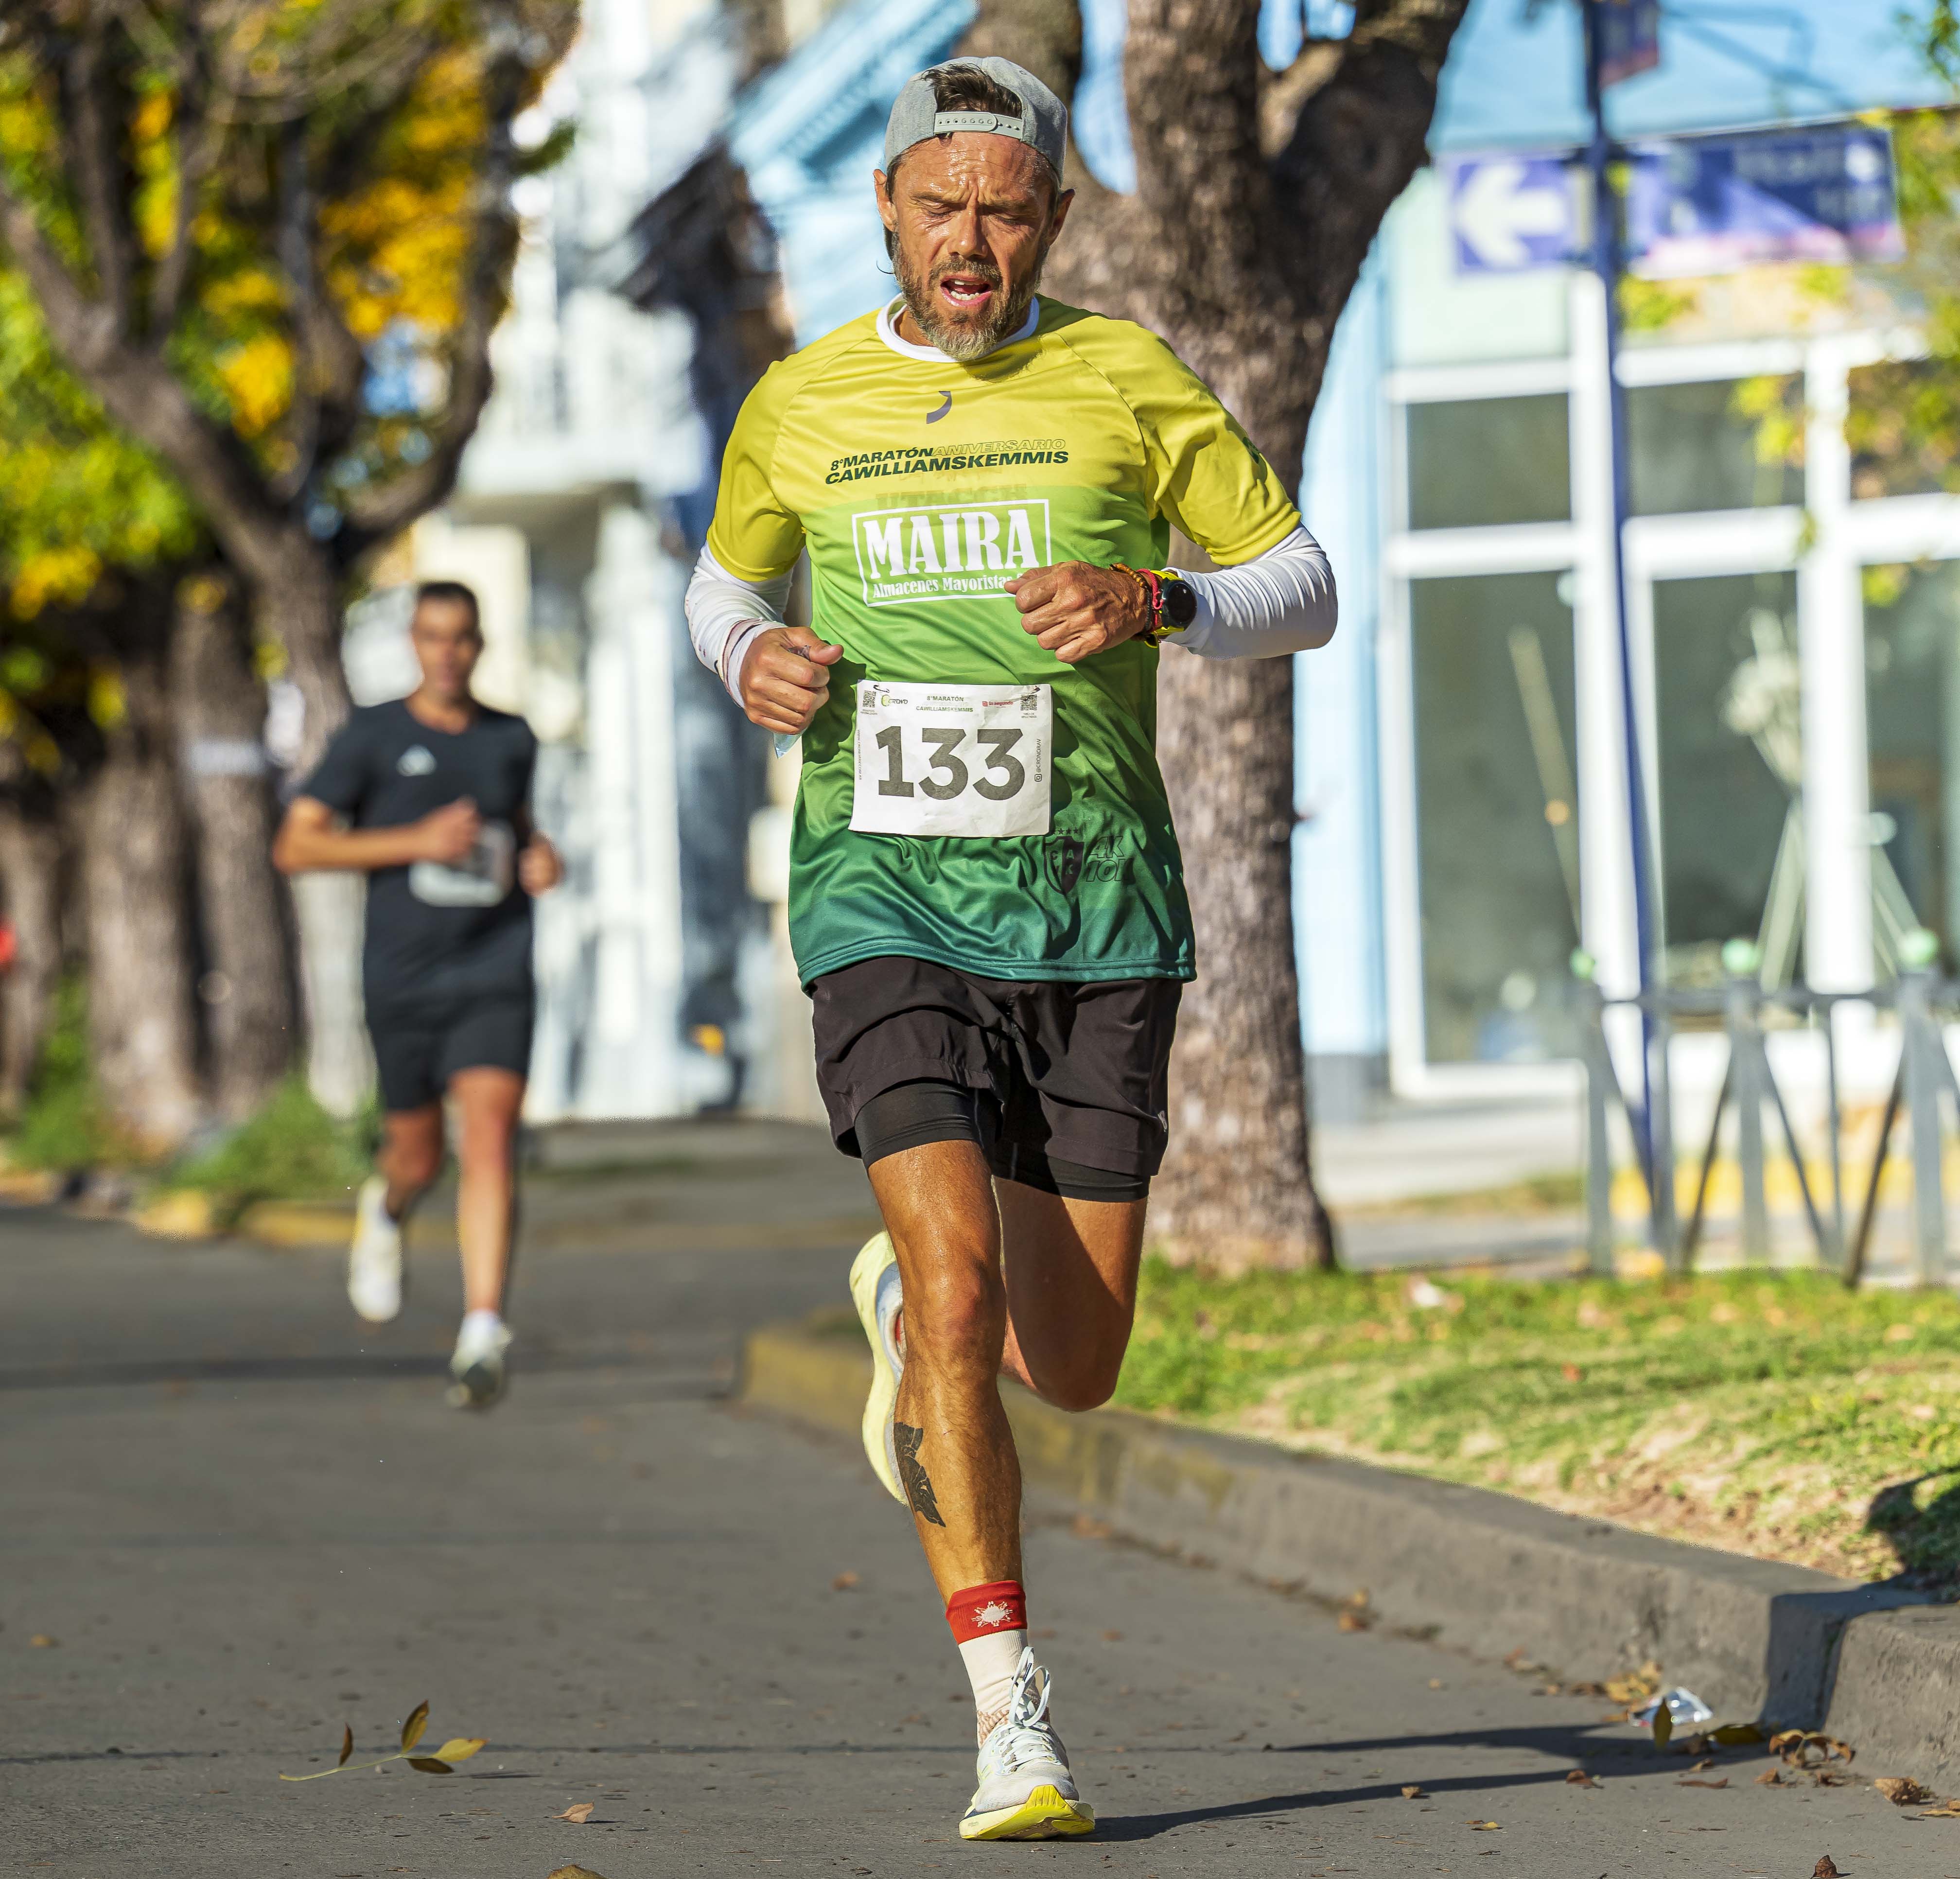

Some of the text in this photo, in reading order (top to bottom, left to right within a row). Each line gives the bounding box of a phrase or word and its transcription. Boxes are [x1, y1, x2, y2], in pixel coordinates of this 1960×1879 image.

[825, 451, 1069, 484] CAWILLIAMSKEMMIS
[863, 509, 1039, 579] MAIRA
[873, 579, 939, 598] Almacenes
[875, 725, 1026, 801] 133
